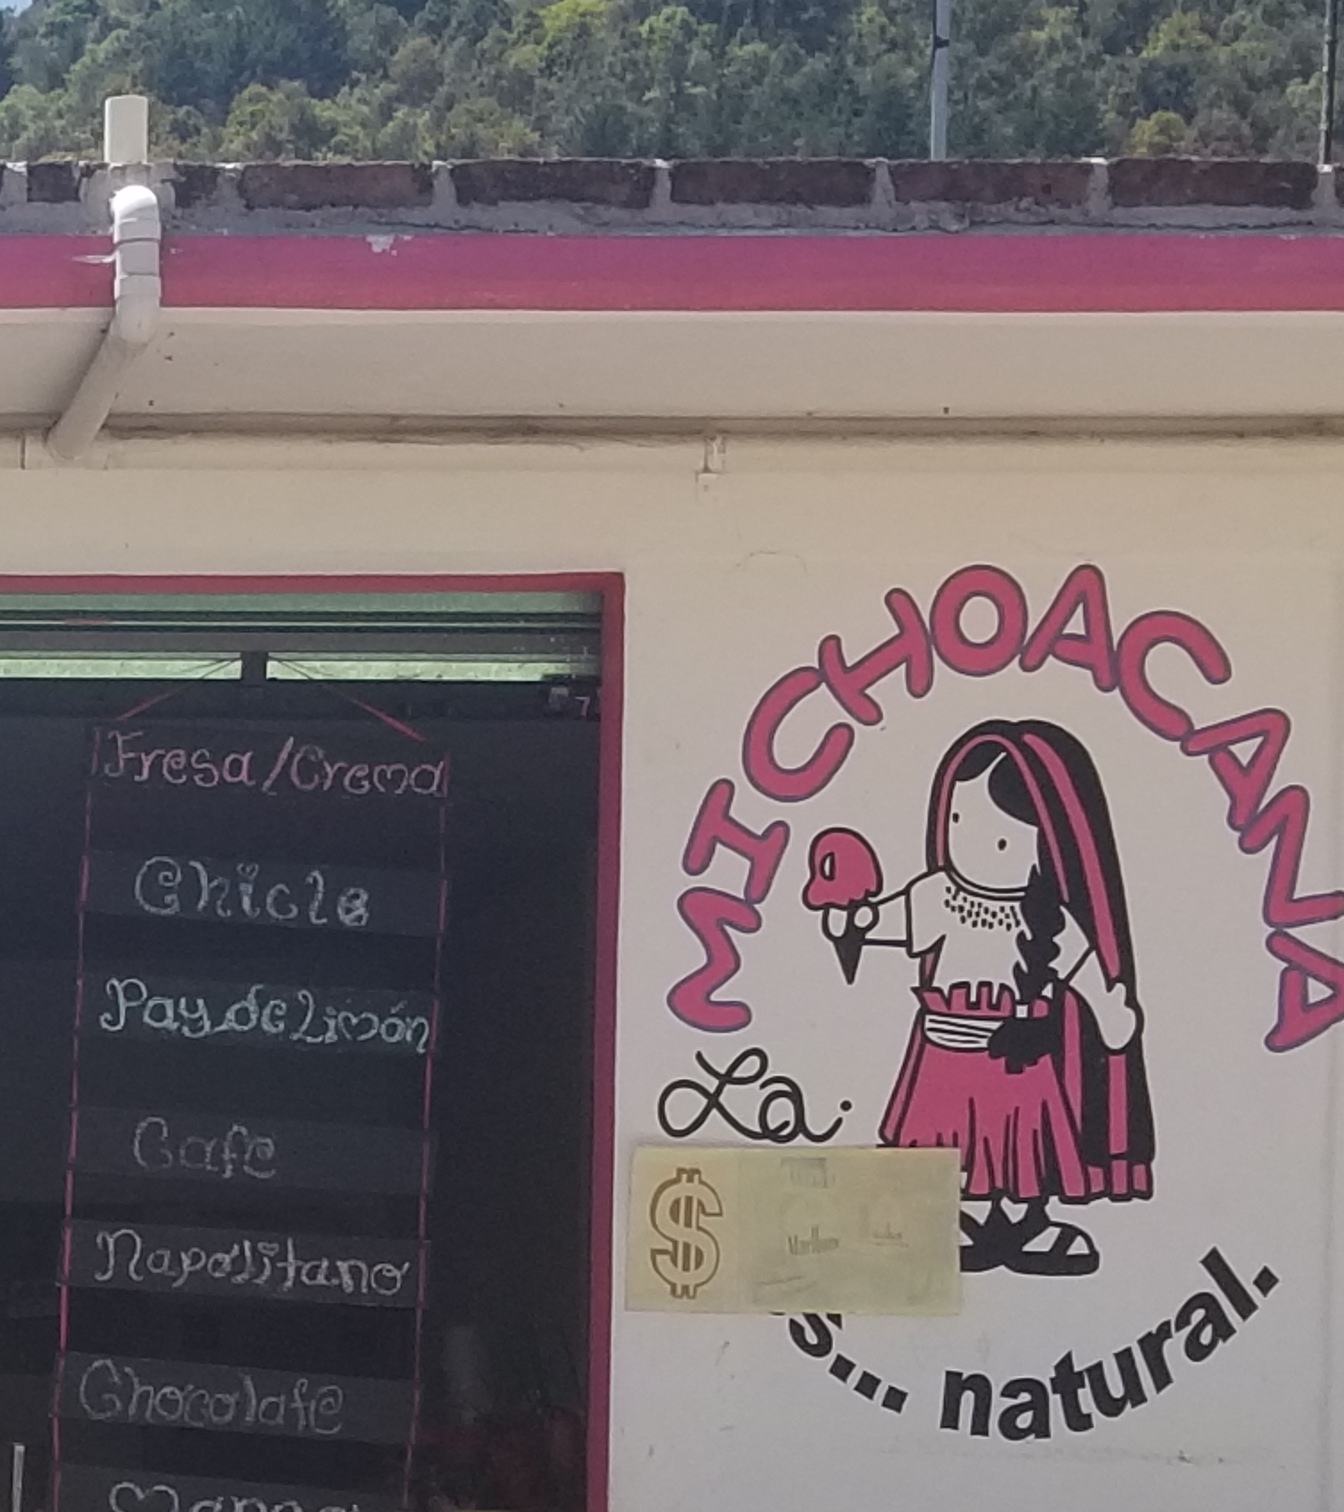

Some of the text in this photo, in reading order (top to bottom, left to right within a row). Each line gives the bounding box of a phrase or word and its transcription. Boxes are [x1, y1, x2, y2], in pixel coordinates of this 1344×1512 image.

[666, 563, 1344, 1053] MICHOACANA
[133, 854, 371, 928] Chicle
[94, 1228, 411, 1296] Napolitano
[938, 1245, 1281, 1441] natural.
[78, 1357, 345, 1435] Chocolate
